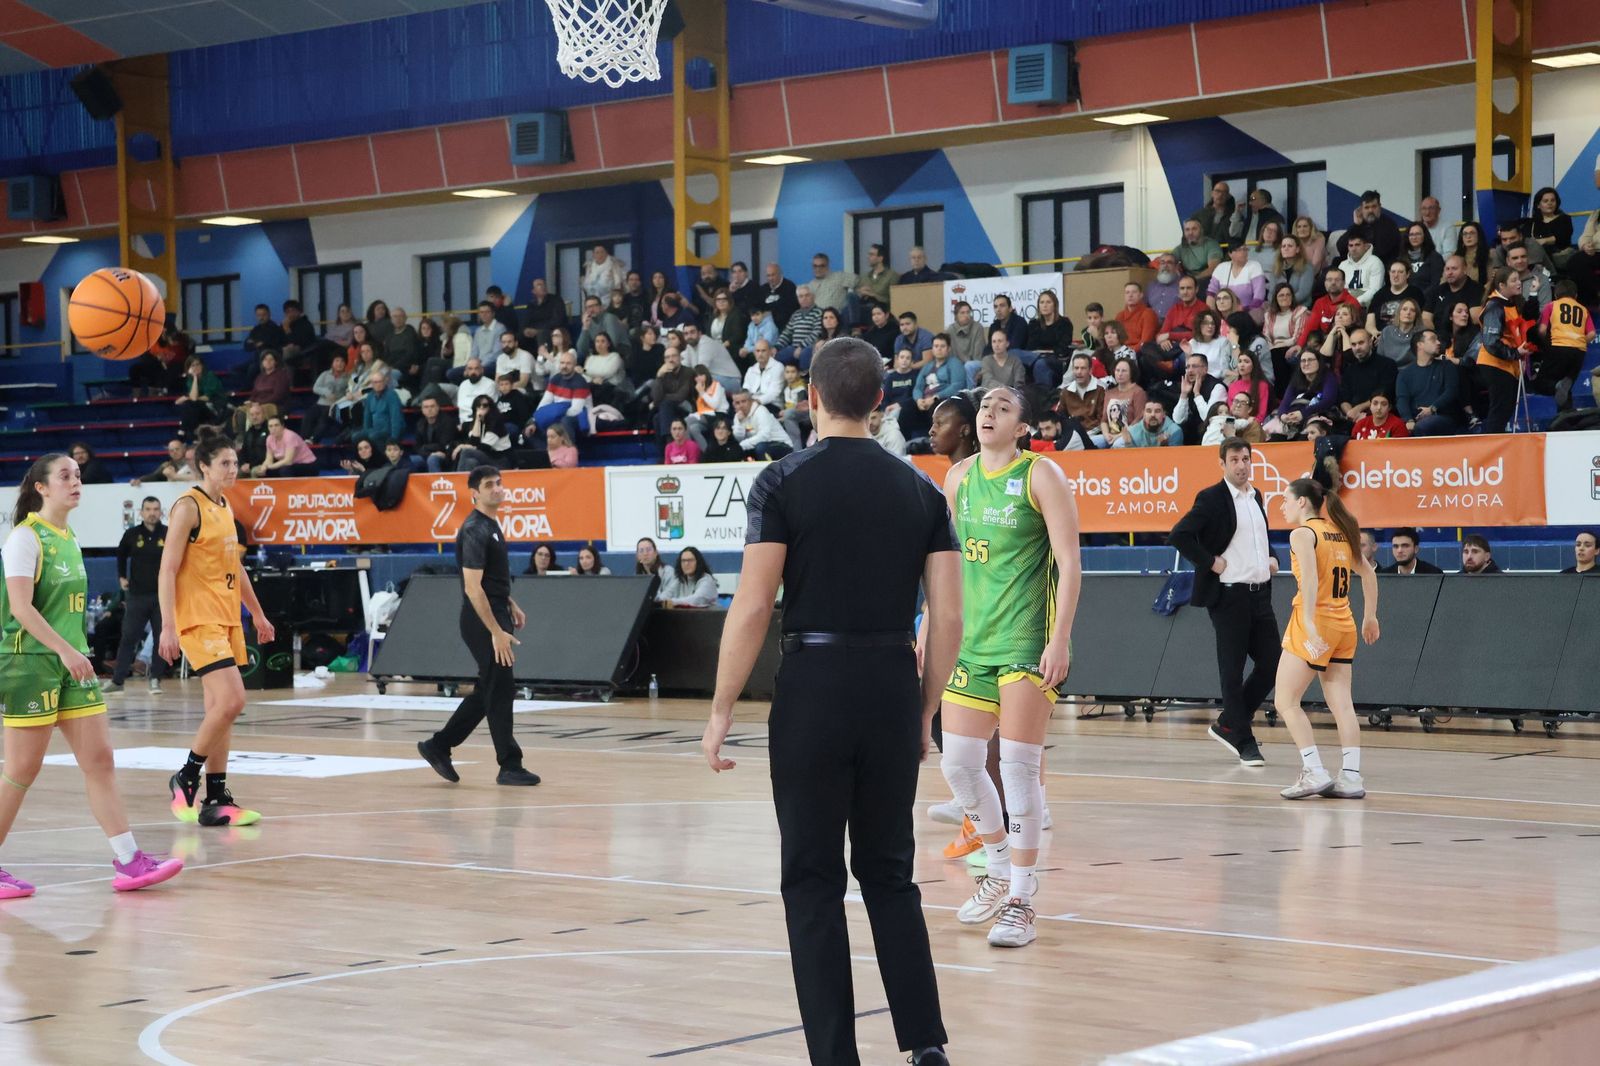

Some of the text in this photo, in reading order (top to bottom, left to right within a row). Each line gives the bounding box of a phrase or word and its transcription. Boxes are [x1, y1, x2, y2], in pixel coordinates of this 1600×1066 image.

[1559, 303, 1583, 328] 80
[1119, 467, 1179, 495] salud
[1342, 457, 1503, 489] oletas salud
[704, 476, 748, 517] ZA
[1106, 500, 1179, 515] ZAMORA
[1417, 493, 1504, 508] ZAMORA
[283, 518, 360, 541] ZAMORA
[704, 526, 749, 540] AYUNT
[965, 536, 989, 564] 55
[1332, 566, 1348, 598] 13
[68, 592, 85, 613] 16
[41, 688, 59, 711] 16
